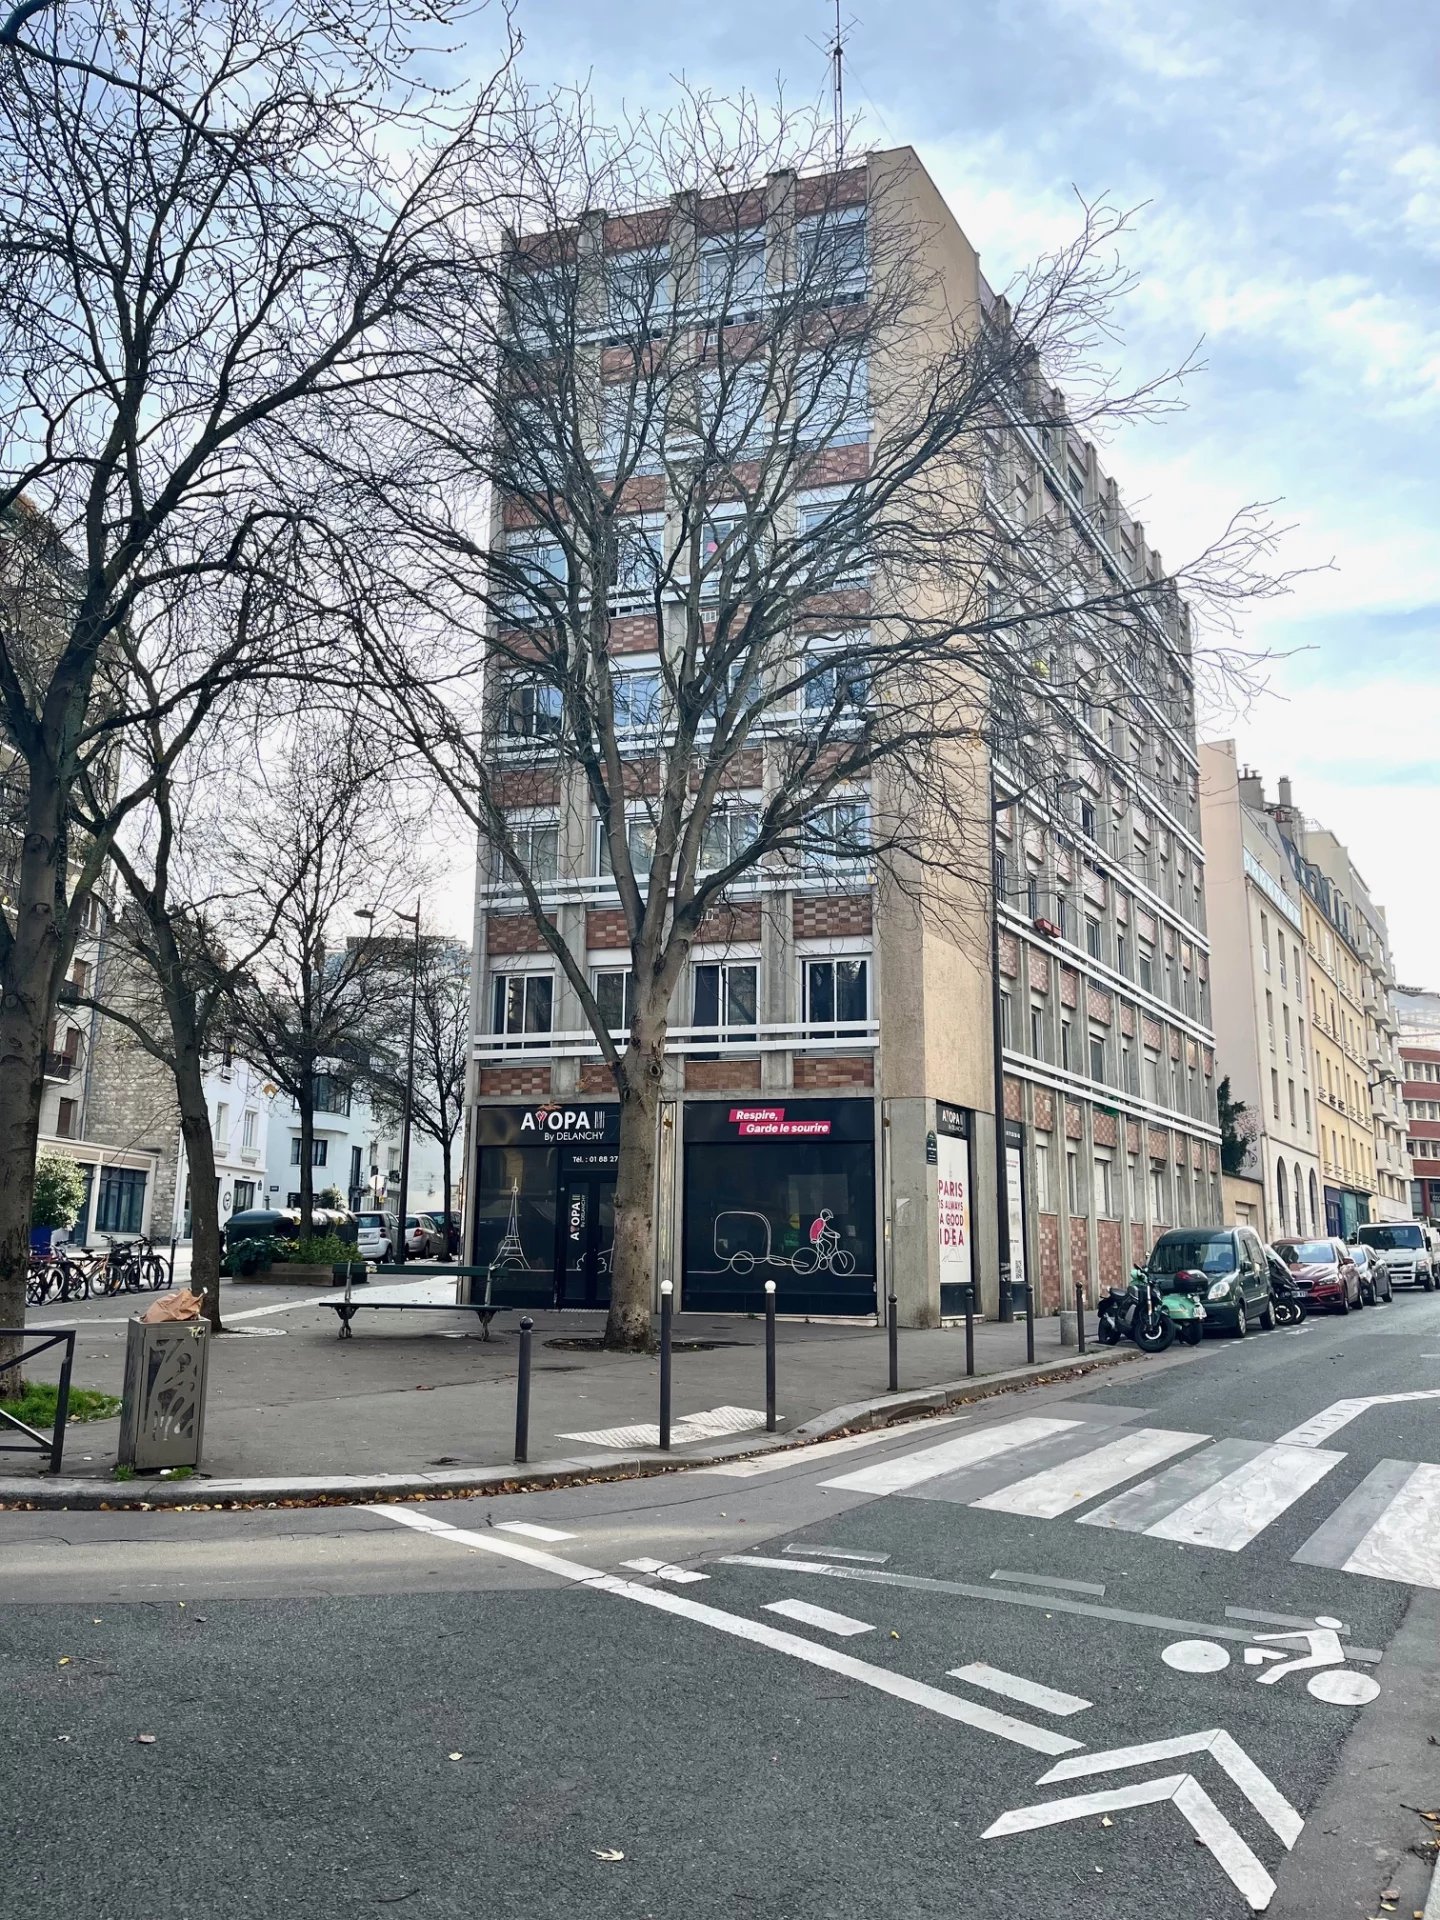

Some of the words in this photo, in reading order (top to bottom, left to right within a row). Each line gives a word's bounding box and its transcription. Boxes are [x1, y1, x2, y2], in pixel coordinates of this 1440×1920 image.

[520, 1110, 591, 1131] AYOPA
[736, 1110, 778, 1121] Respire,
[746, 1123, 778, 1133] Garde
[780, 1123, 789, 1132] le
[791, 1123, 829, 1132] sourire
[544, 1133, 555, 1142] By
[556, 1131, 604, 1141] DELANCHY
[589, 1155, 597, 1163] 01
[609, 1155, 619, 1163] 27
[938, 1180, 963, 1198] PARIS
[945, 1200, 963, 1211] ALWAYS
[940, 1213, 944, 1225] A
[946, 1213, 963, 1227] GOOD
[940, 1228, 964, 1246] IDEA
